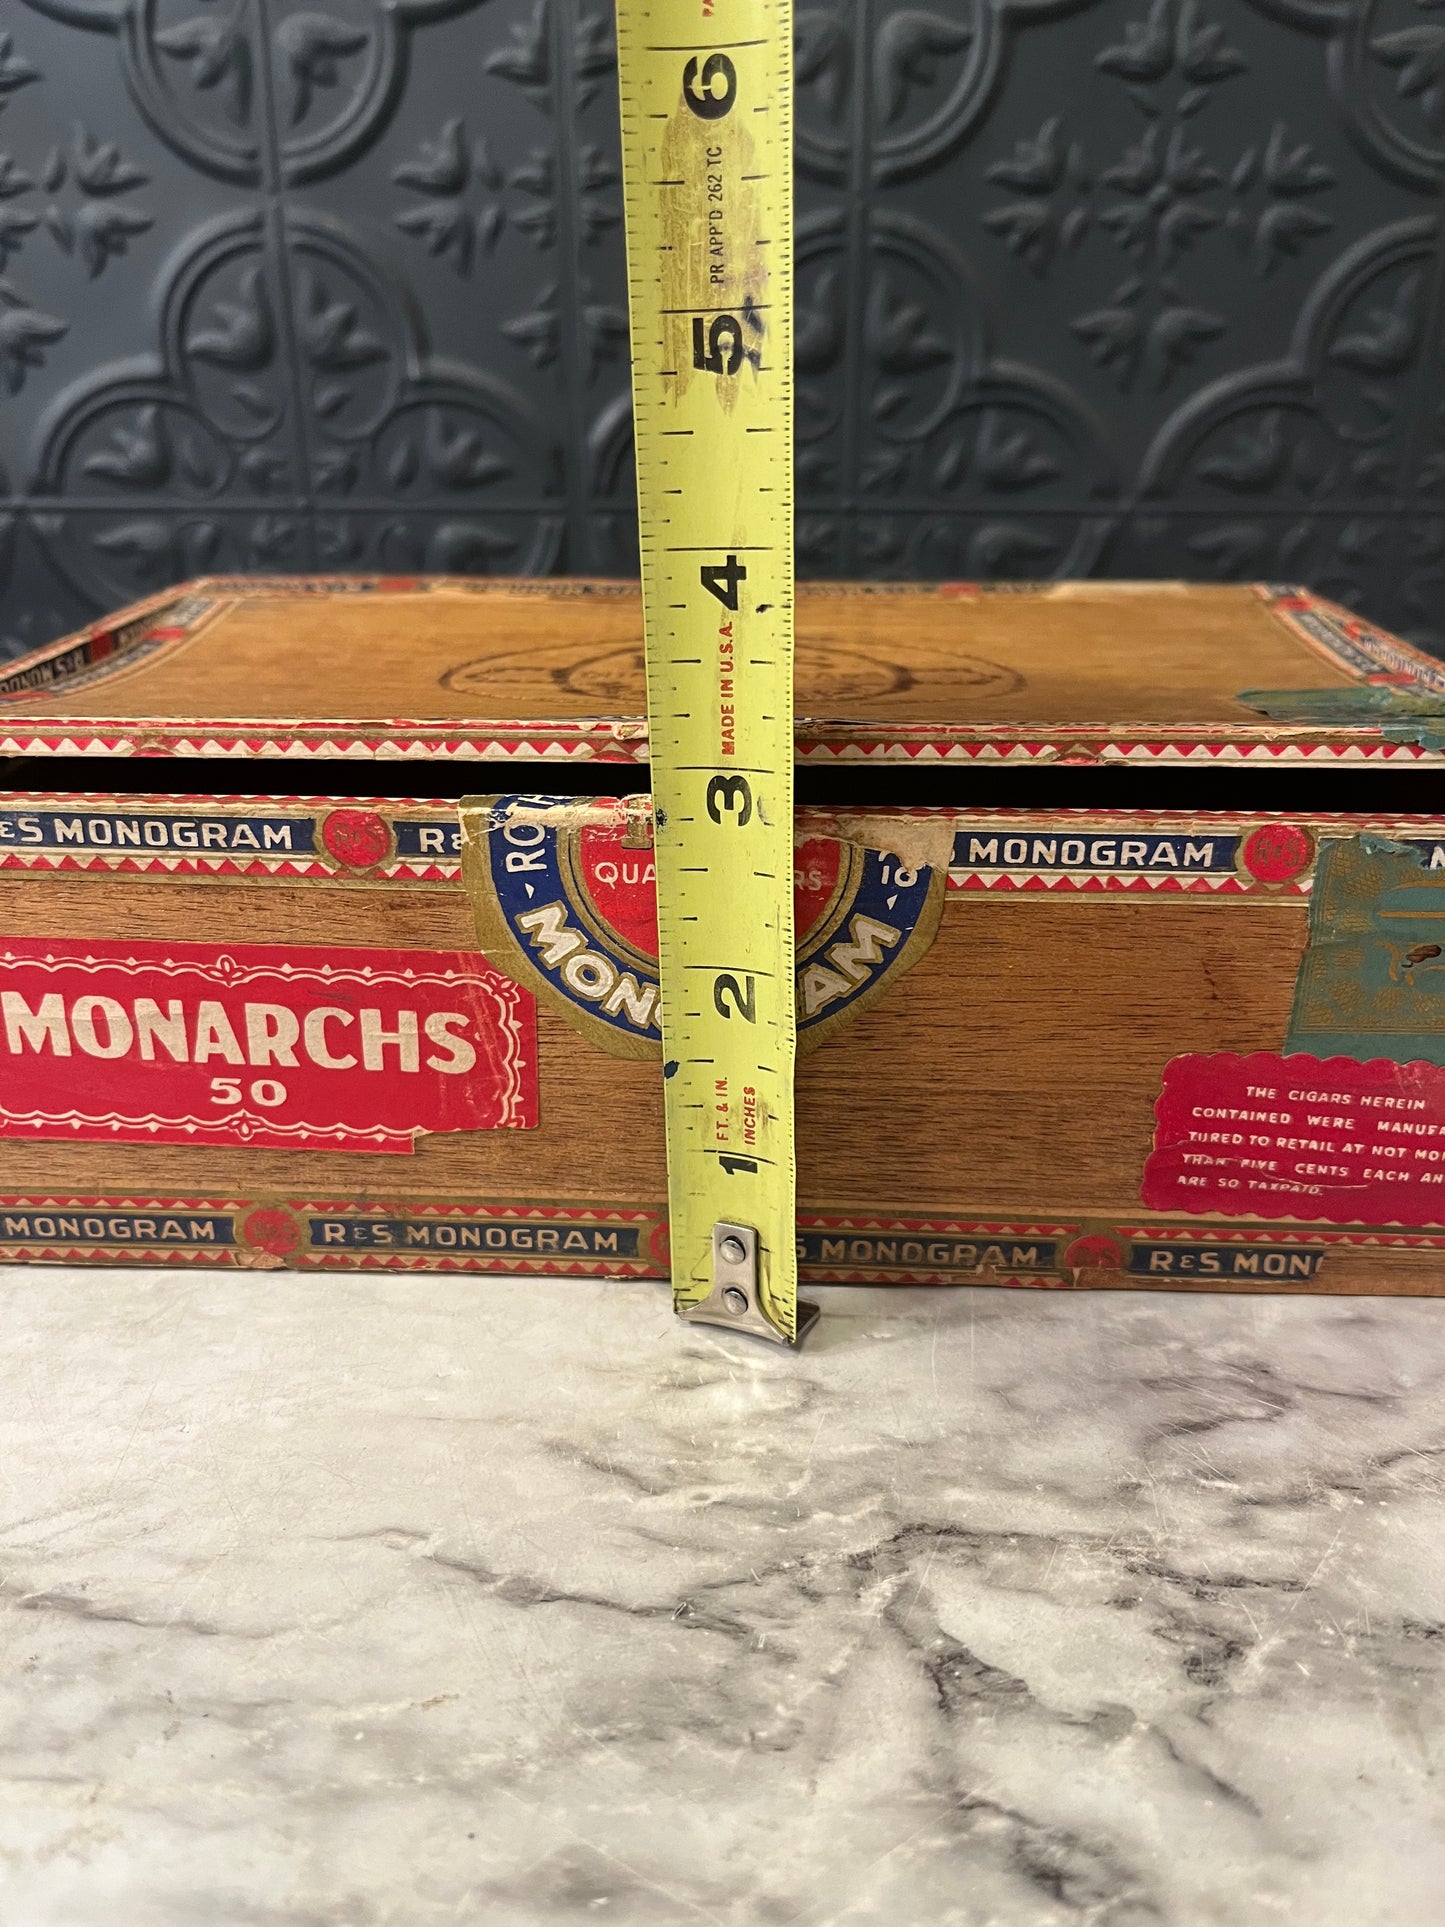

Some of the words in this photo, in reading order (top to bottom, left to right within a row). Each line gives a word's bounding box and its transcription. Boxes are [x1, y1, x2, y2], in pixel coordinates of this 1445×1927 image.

[683, 53, 737, 120] 6
[706, 146, 722, 167] TC
[708, 174, 722, 201] 262
[710, 264, 724, 283] PR
[692, 314, 742, 376] 5
[700, 555, 747, 611] 4
[720, 679, 733, 698] IN
[720, 704, 735, 755] MADE
[706, 774, 752, 827] 3
[54, 818, 293, 850] MONOGRAM
[968, 837, 1214, 868] MONOGRAM
[713, 973, 757, 1024] 2
[0, 991, 478, 1075] MONARCHS
[210, 1077, 288, 1107] 50
[1246, 1086, 1277, 1099] THE
[1288, 1090, 1352, 1105] CIGARS
[1360, 1095, 1425, 1110] HEREIN
[743, 1086, 757, 1146] INCHES
[1192, 1107, 1291, 1124] CONTAINED
[1307, 1115, 1355, 1130] WERE
[1189, 1131, 1243, 1145] TURED
[1250, 1134, 1269, 1147] TO
[1276, 1137, 1335, 1153] RETAIL
[1342, 1143, 1365, 1154] AT
[1371, 1145, 1407, 1158] NOT
[718, 1156, 759, 1175] 1
[1295, 1163, 1350, 1178] CENTS
[1363, 1168, 1410, 1182] EACH
[1177, 1175, 1207, 1187] ARE
[1218, 1178, 1240, 1189] SO
[4, 1217, 216, 1240] MONOGRAM
[407, 1225, 618, 1251] MONOGRAM
[821, 1239, 1038, 1268] MONOGRAM
